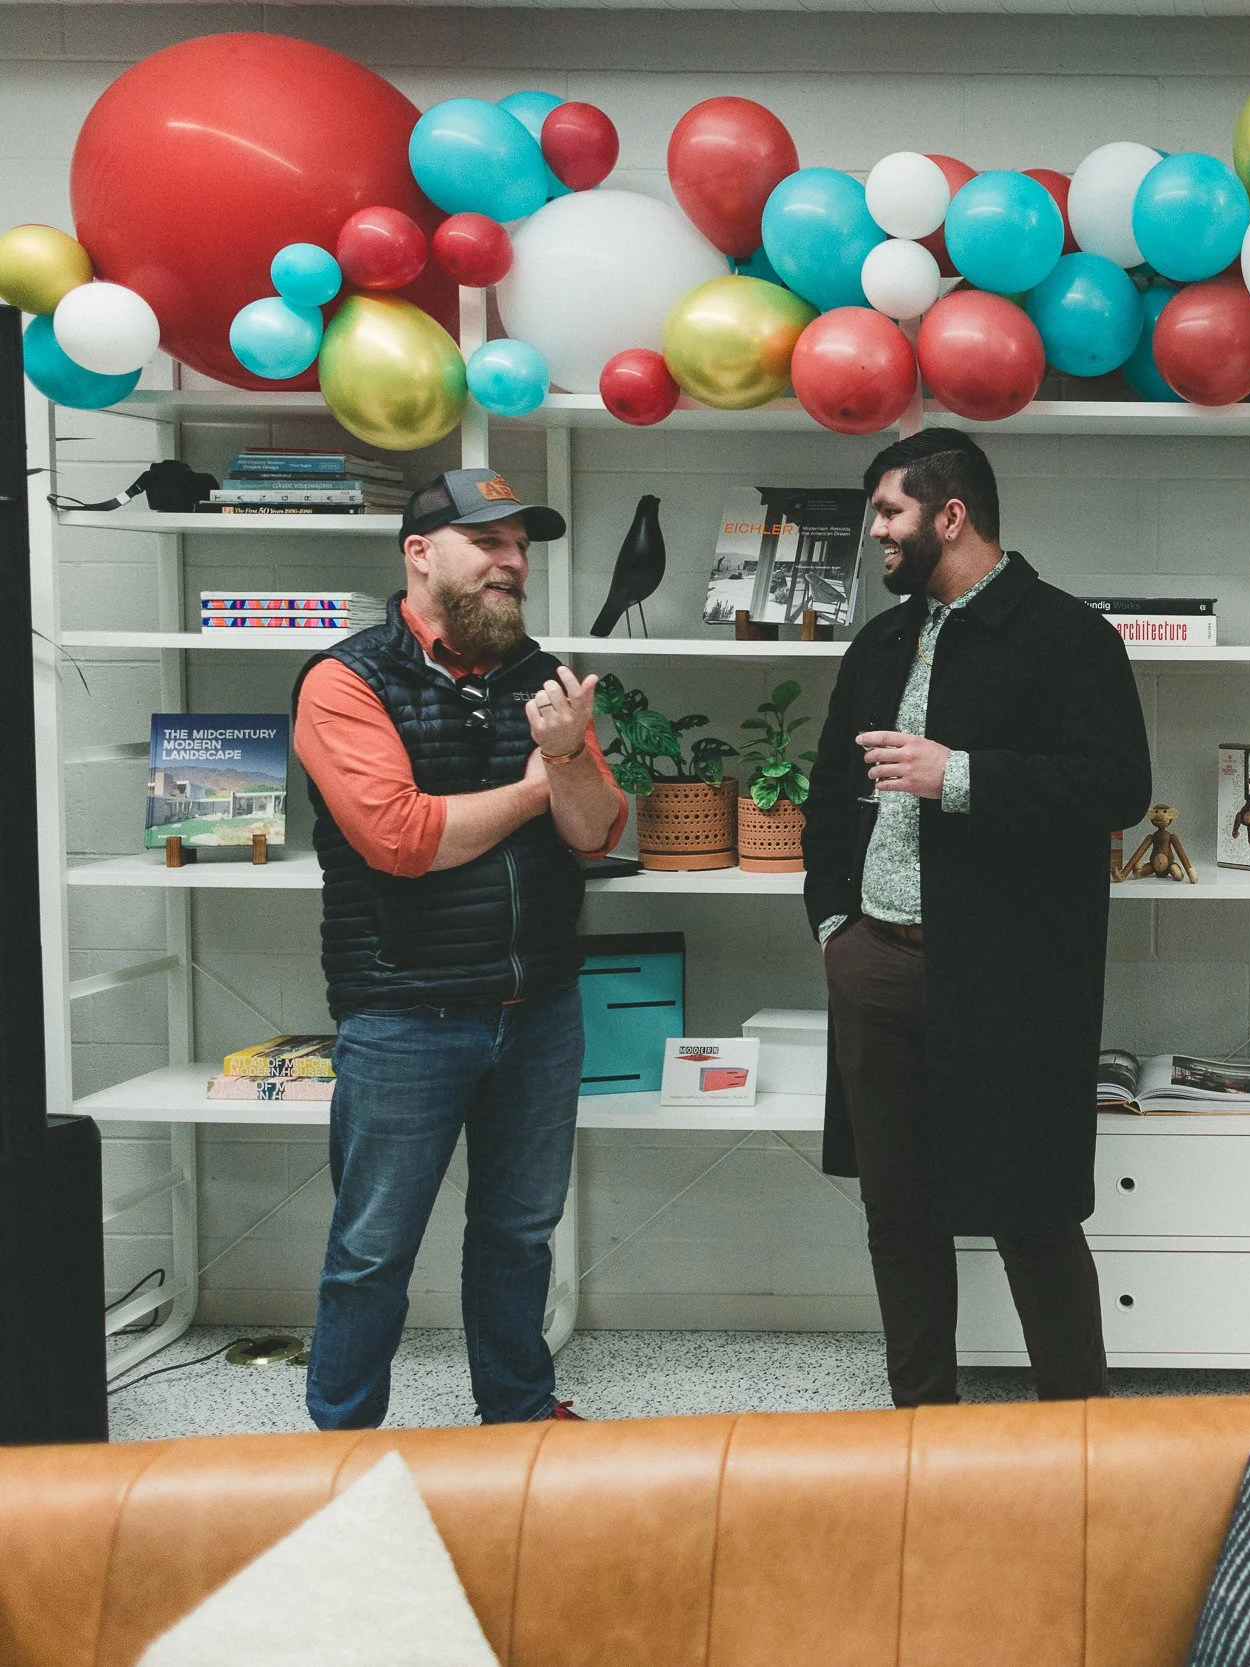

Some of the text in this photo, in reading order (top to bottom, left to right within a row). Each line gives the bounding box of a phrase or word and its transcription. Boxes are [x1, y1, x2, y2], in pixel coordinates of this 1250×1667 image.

[723, 523, 793, 536] EICHLER
[1084, 600, 1140, 610] undig Works
[1117, 620, 1188, 641] architecture
[163, 729, 277, 740] THE MIDCENTURY
[163, 740, 222, 750] MODERN
[162, 750, 242, 760] LANDSCAPE
[679, 1046, 719, 1055] MODERN
[230, 1057, 332, 1068] ATLAS OF MID-CEN
[229, 1067, 328, 1077] MODERN HOUSES
[255, 1080, 271, 1091] OF
